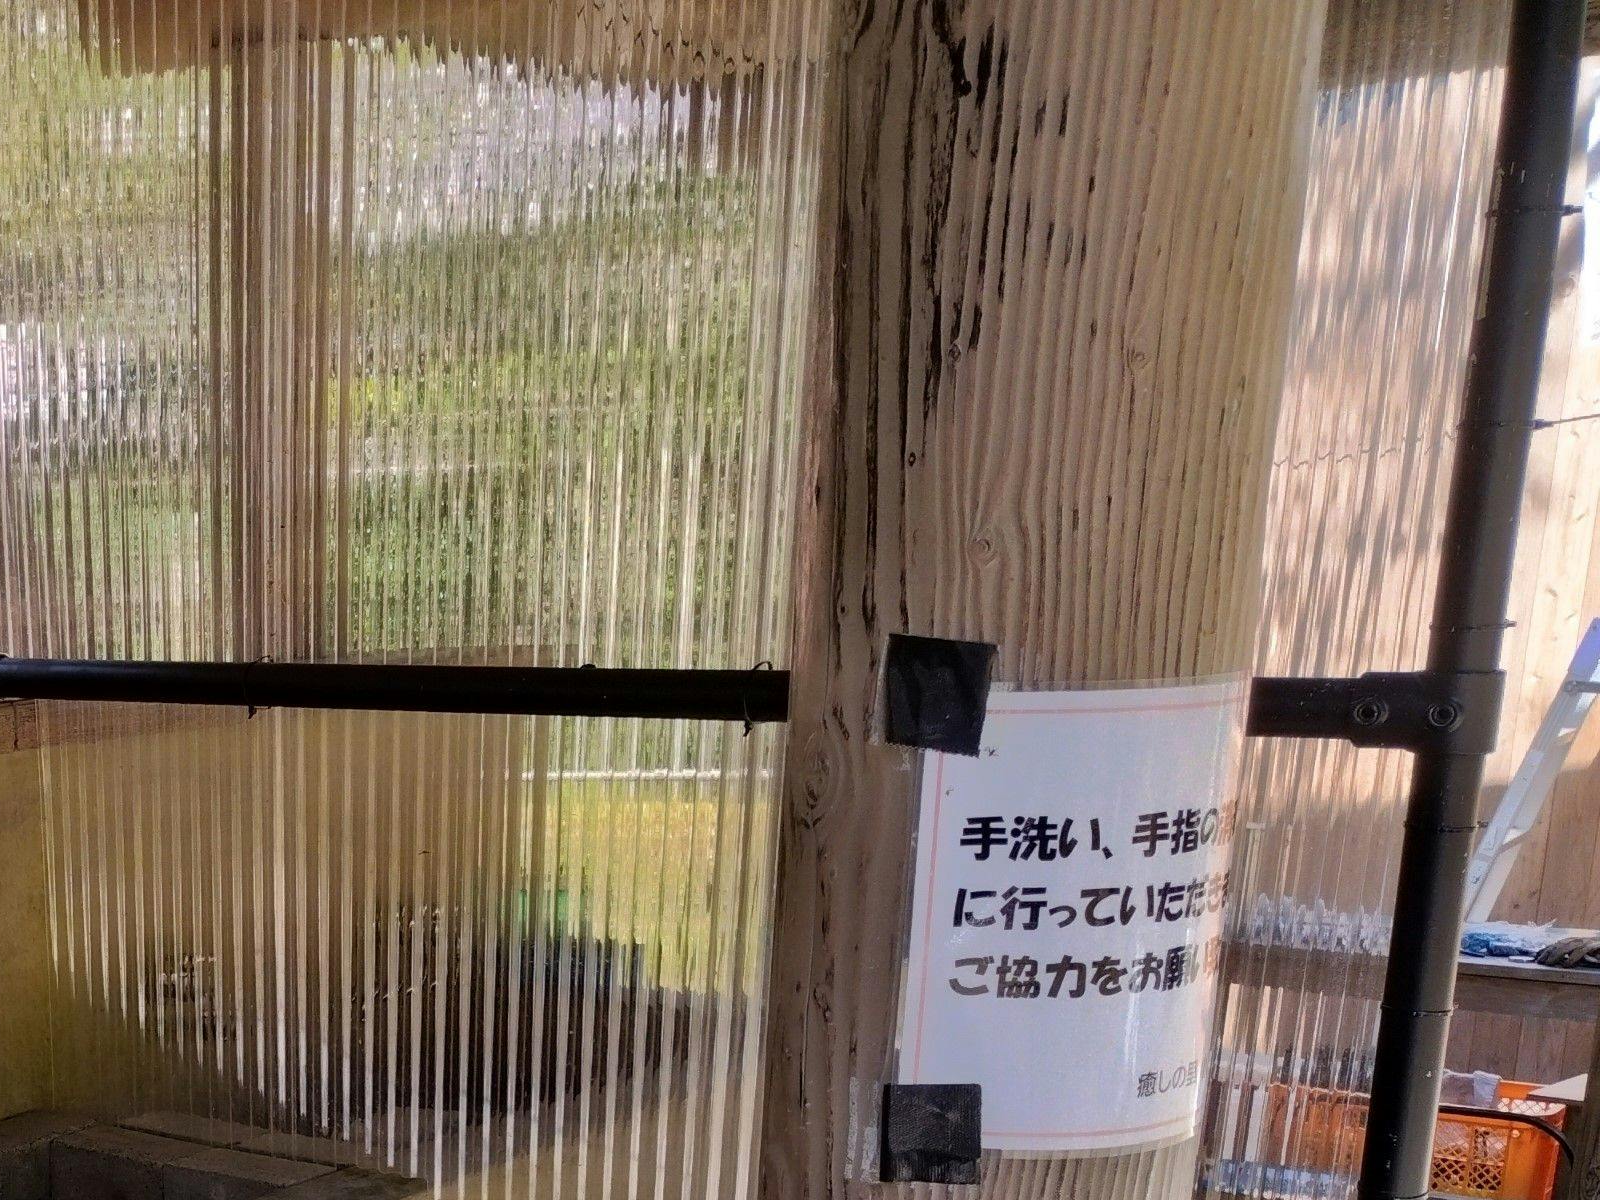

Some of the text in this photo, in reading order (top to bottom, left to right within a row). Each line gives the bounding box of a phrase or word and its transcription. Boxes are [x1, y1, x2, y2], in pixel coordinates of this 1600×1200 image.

[953, 869, 1229, 931] に行っていただき
